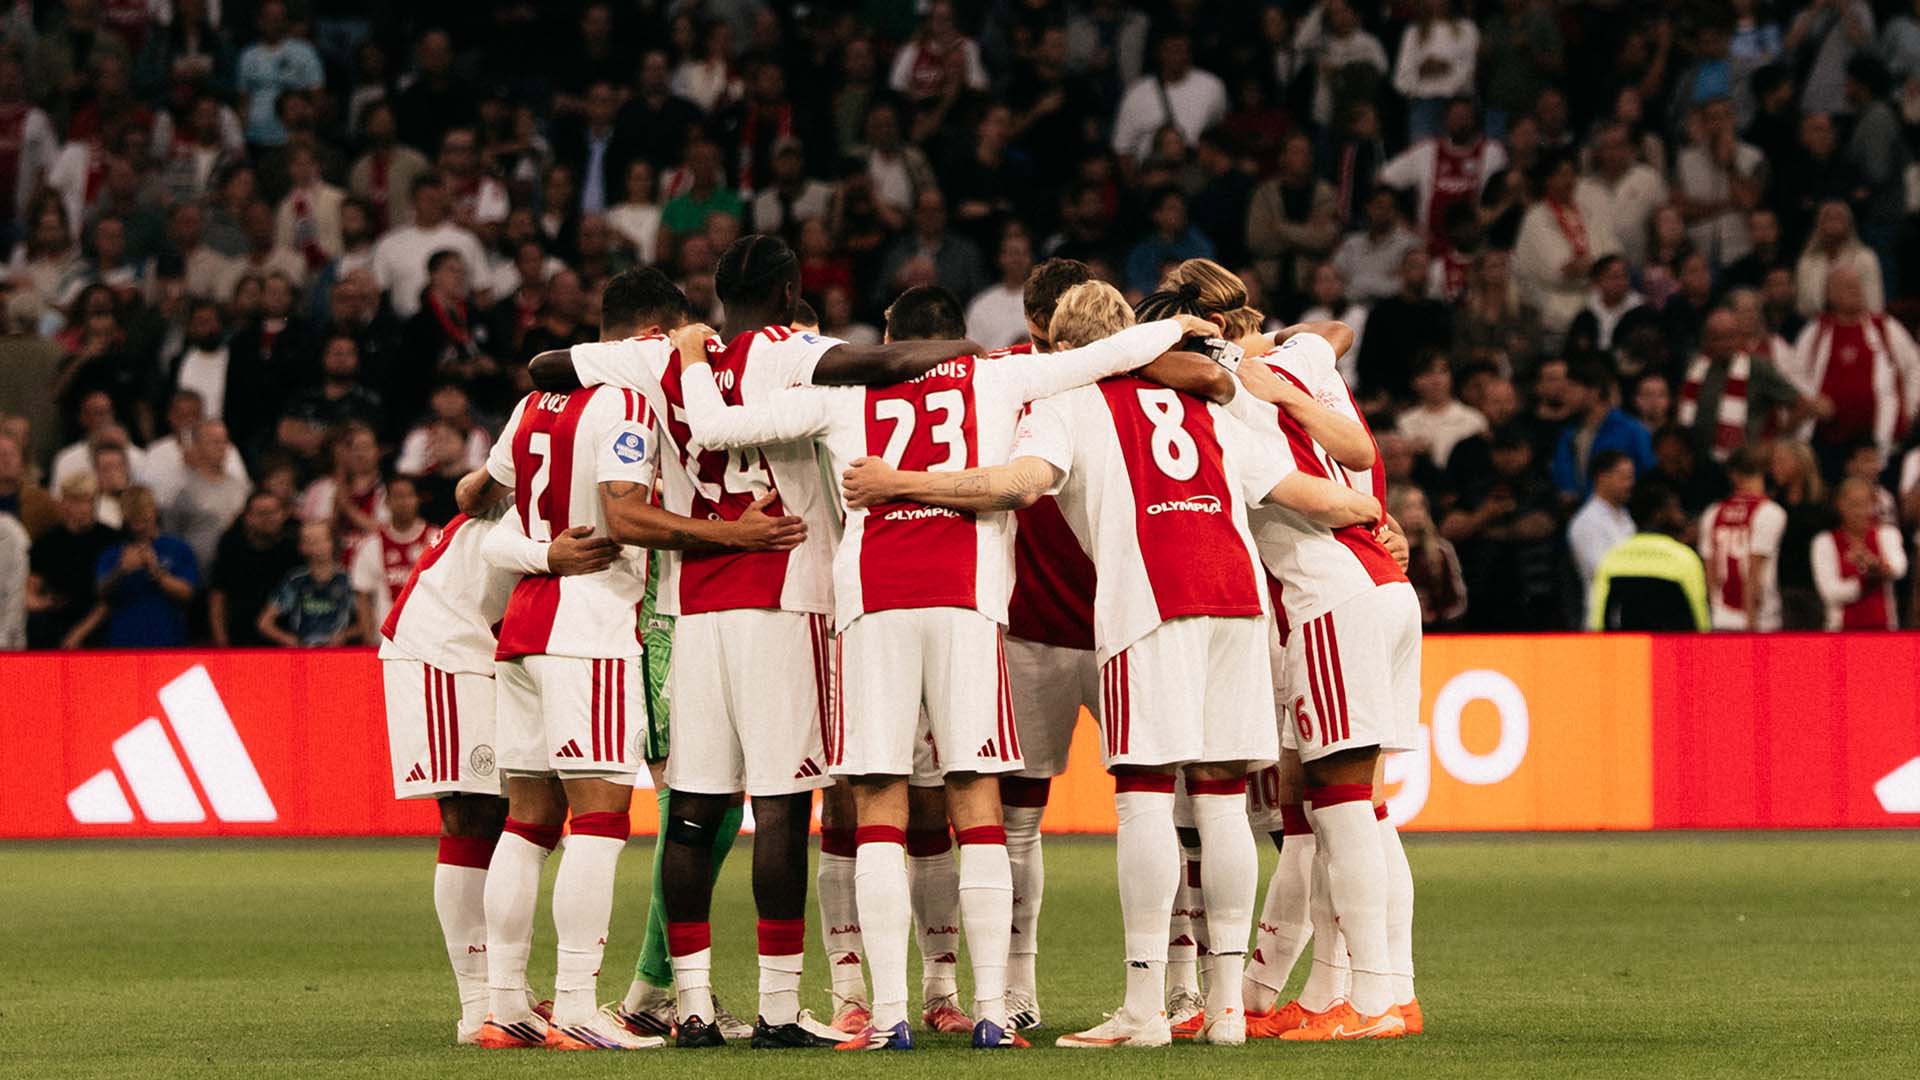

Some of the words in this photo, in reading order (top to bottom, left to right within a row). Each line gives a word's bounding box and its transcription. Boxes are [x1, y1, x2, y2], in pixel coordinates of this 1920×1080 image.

[875, 389, 967, 473] 23
[1137, 388, 1199, 481] 8
[529, 432, 552, 541] 2
[1146, 496, 1222, 515] OLYMPIA
[1295, 695, 1313, 743] 6
[1248, 765, 1280, 812] 10
[927, 925, 959, 936] AJAX
